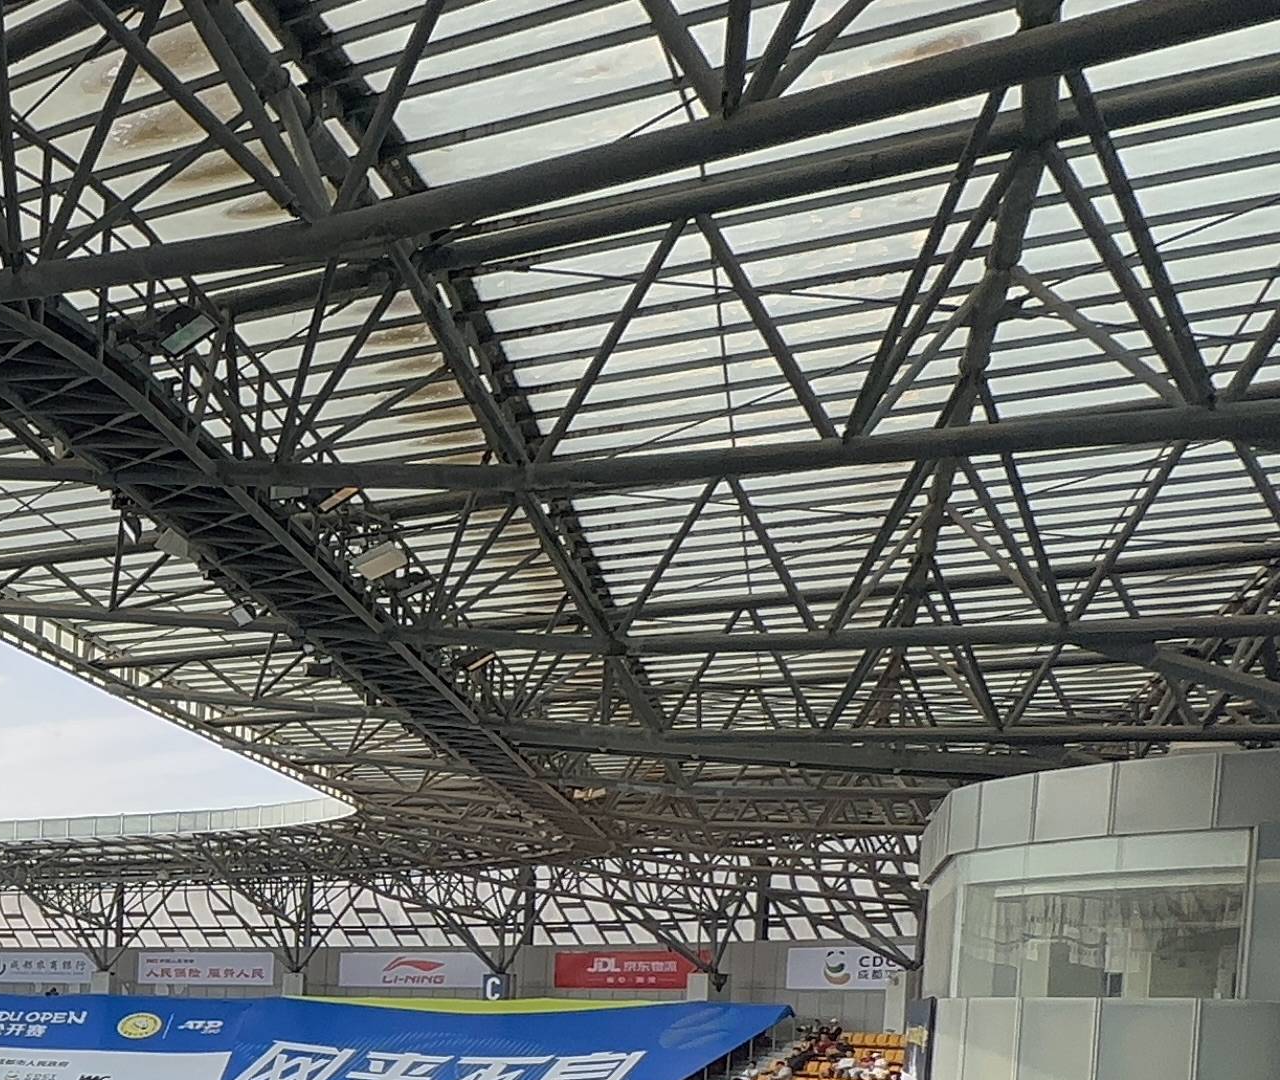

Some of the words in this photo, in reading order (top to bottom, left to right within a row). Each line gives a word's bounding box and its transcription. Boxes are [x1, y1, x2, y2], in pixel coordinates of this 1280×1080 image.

[586, 957, 621, 973] JDL
[858, 955, 896, 968] CDC
[382, 974, 445, 985] LI-NING
[486, 975, 501, 1001] C
[26, 1010, 87, 1025] OPEN
[178, 1020, 224, 1030] ATP
